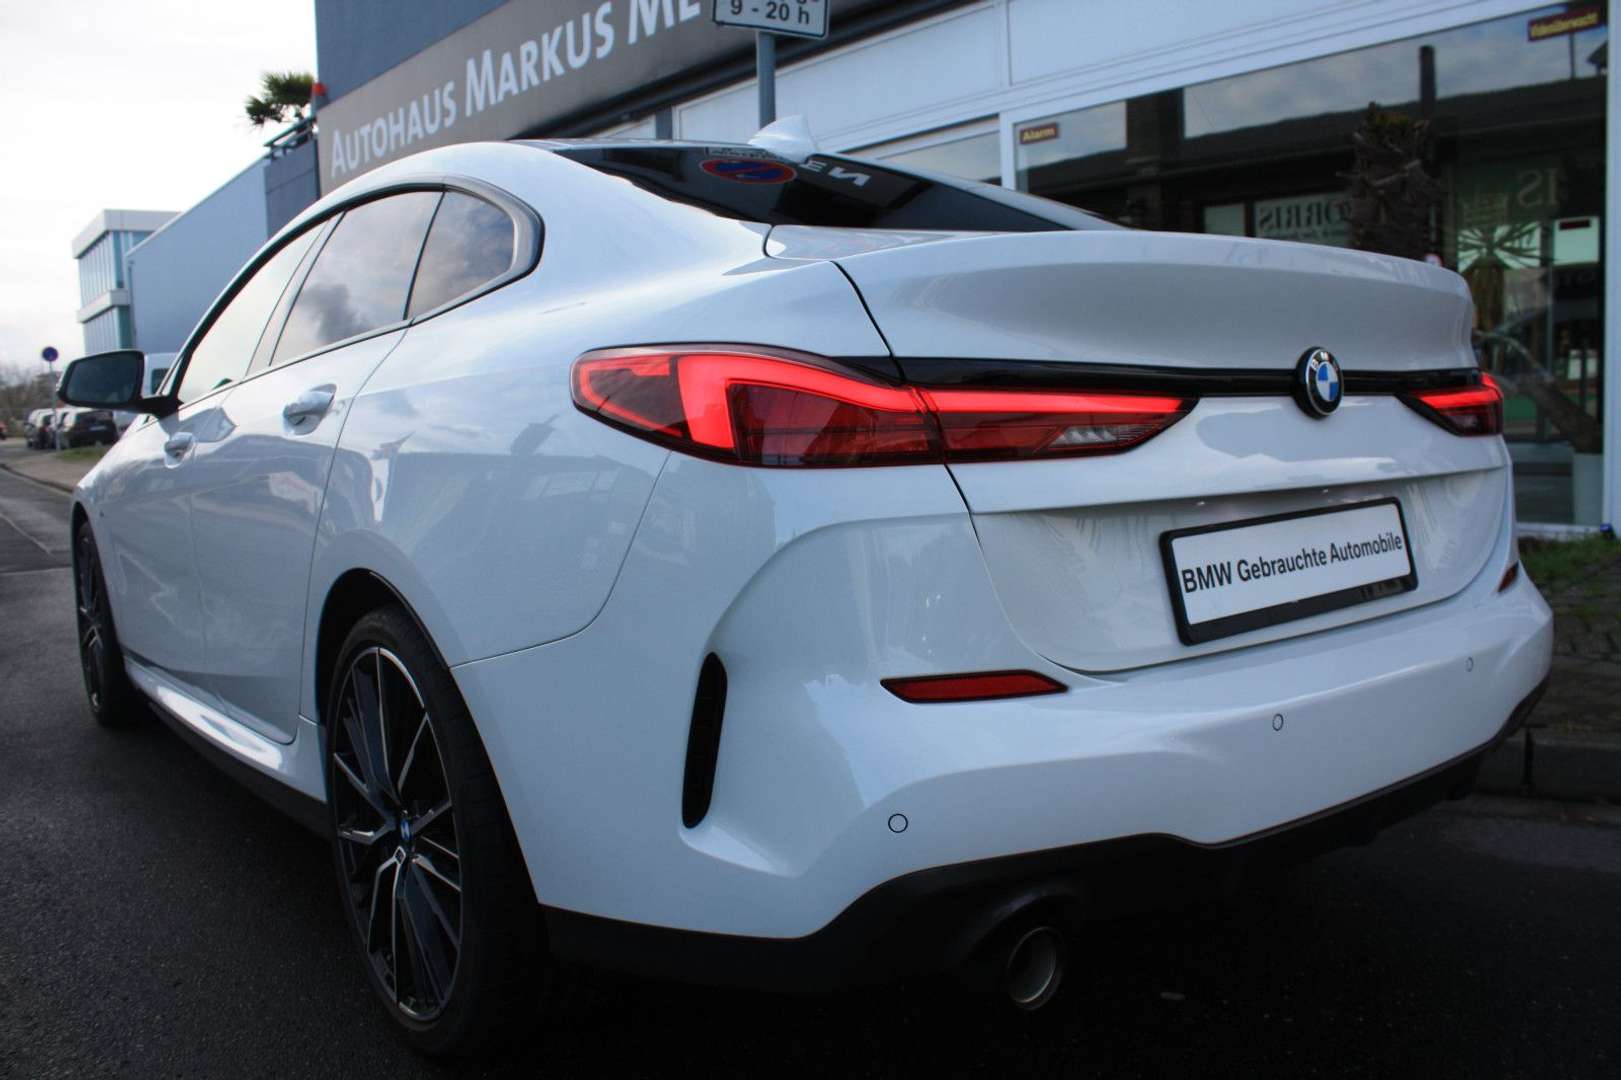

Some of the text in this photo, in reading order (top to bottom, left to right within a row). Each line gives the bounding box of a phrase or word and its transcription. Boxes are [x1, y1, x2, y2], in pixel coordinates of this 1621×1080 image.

[731, 0, 743, 15] 9
[766, 1, 790, 21] 20
[798, 6, 810, 25] h
[331, 80, 458, 179] AUTOHAUS
[465, 1, 615, 117] MARKUS
[1181, 532, 1403, 593] BMW Gebrauchte Automobile
